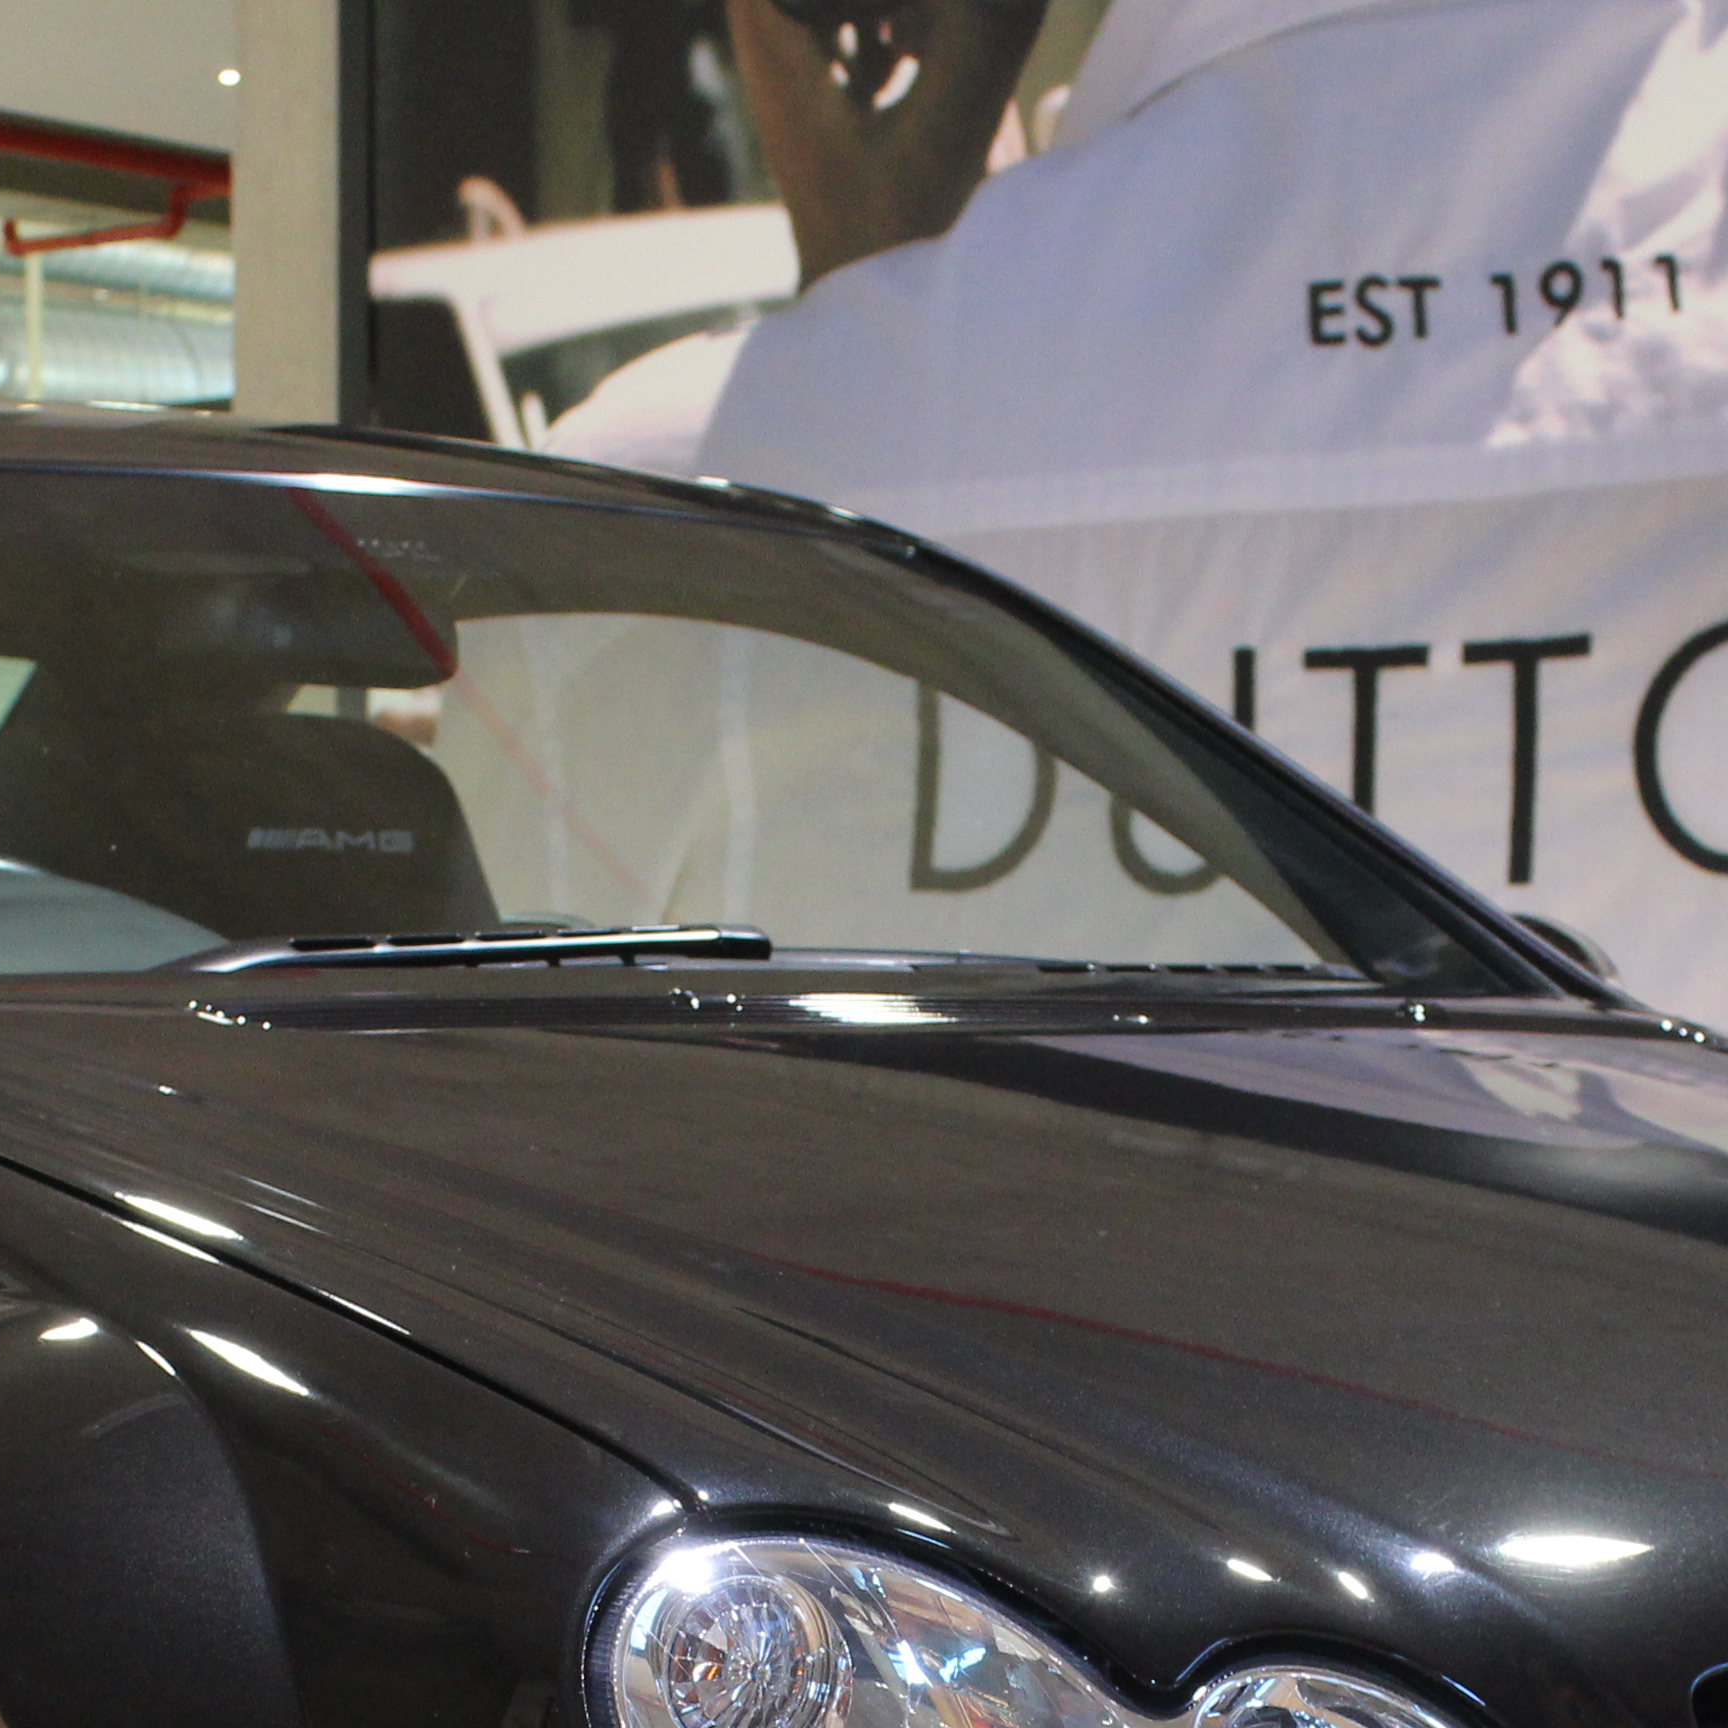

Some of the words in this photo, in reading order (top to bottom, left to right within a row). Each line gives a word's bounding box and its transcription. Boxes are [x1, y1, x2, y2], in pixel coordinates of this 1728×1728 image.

[1307, 273, 1442, 348] EST
[1489, 253, 1682, 336] 1911
[295, 828, 414, 852] AMG
